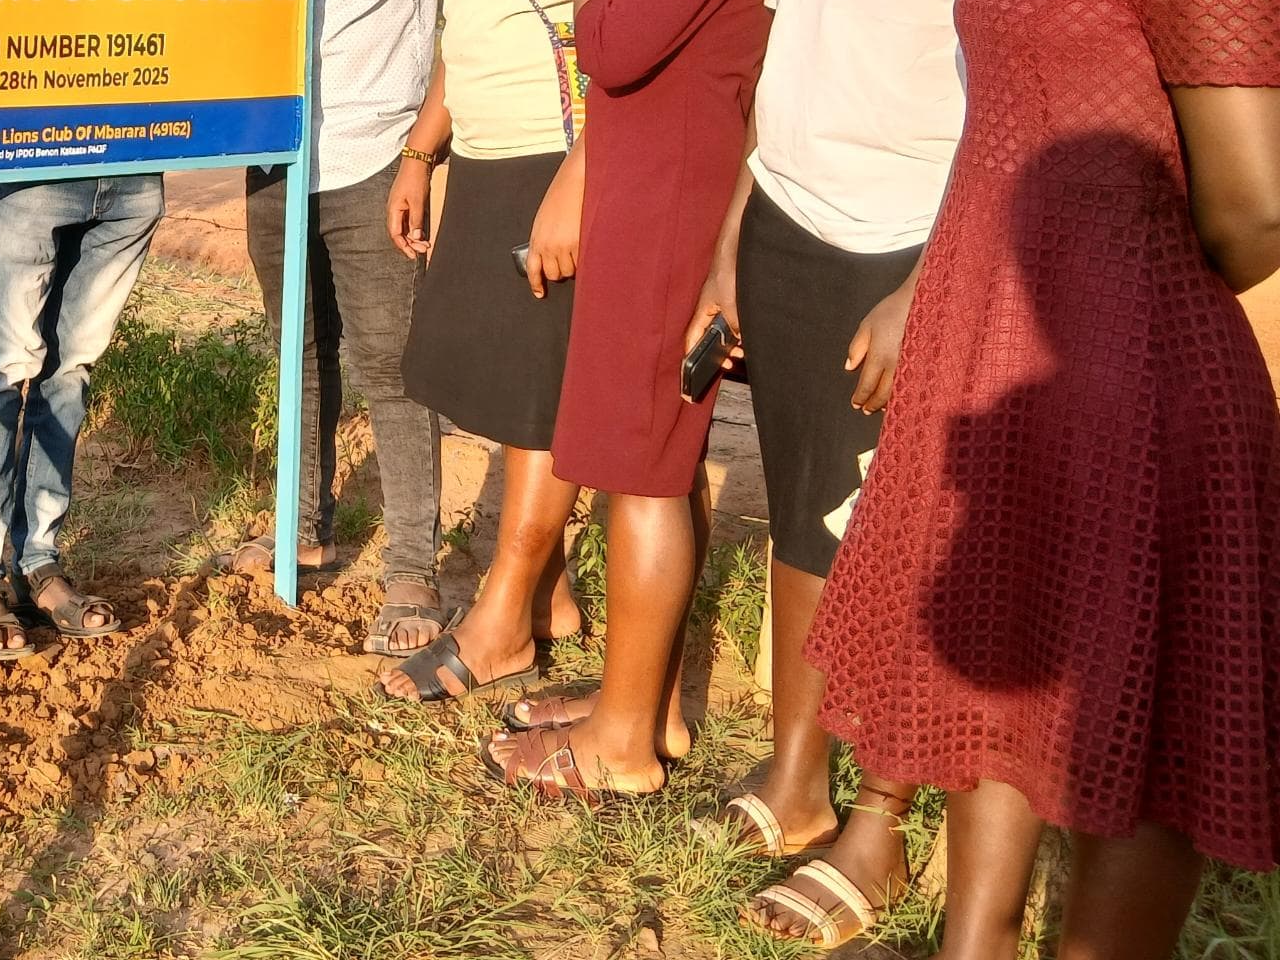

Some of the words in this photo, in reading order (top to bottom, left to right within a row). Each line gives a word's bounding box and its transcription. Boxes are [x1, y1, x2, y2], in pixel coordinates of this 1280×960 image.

[6, 34, 101, 60] NUMBER
[106, 33, 165, 57] 191461
[0, 70, 38, 90] 28th
[43, 68, 129, 89] November
[132, 67, 169, 86] 2025
[3, 128, 39, 145] Lions
[42, 126, 72, 142] Club
[76, 125, 92, 140] Of
[94, 123, 146, 140] Mbarara
[149, 121, 191, 140] (49162)
[5, 149, 15, 161] by
